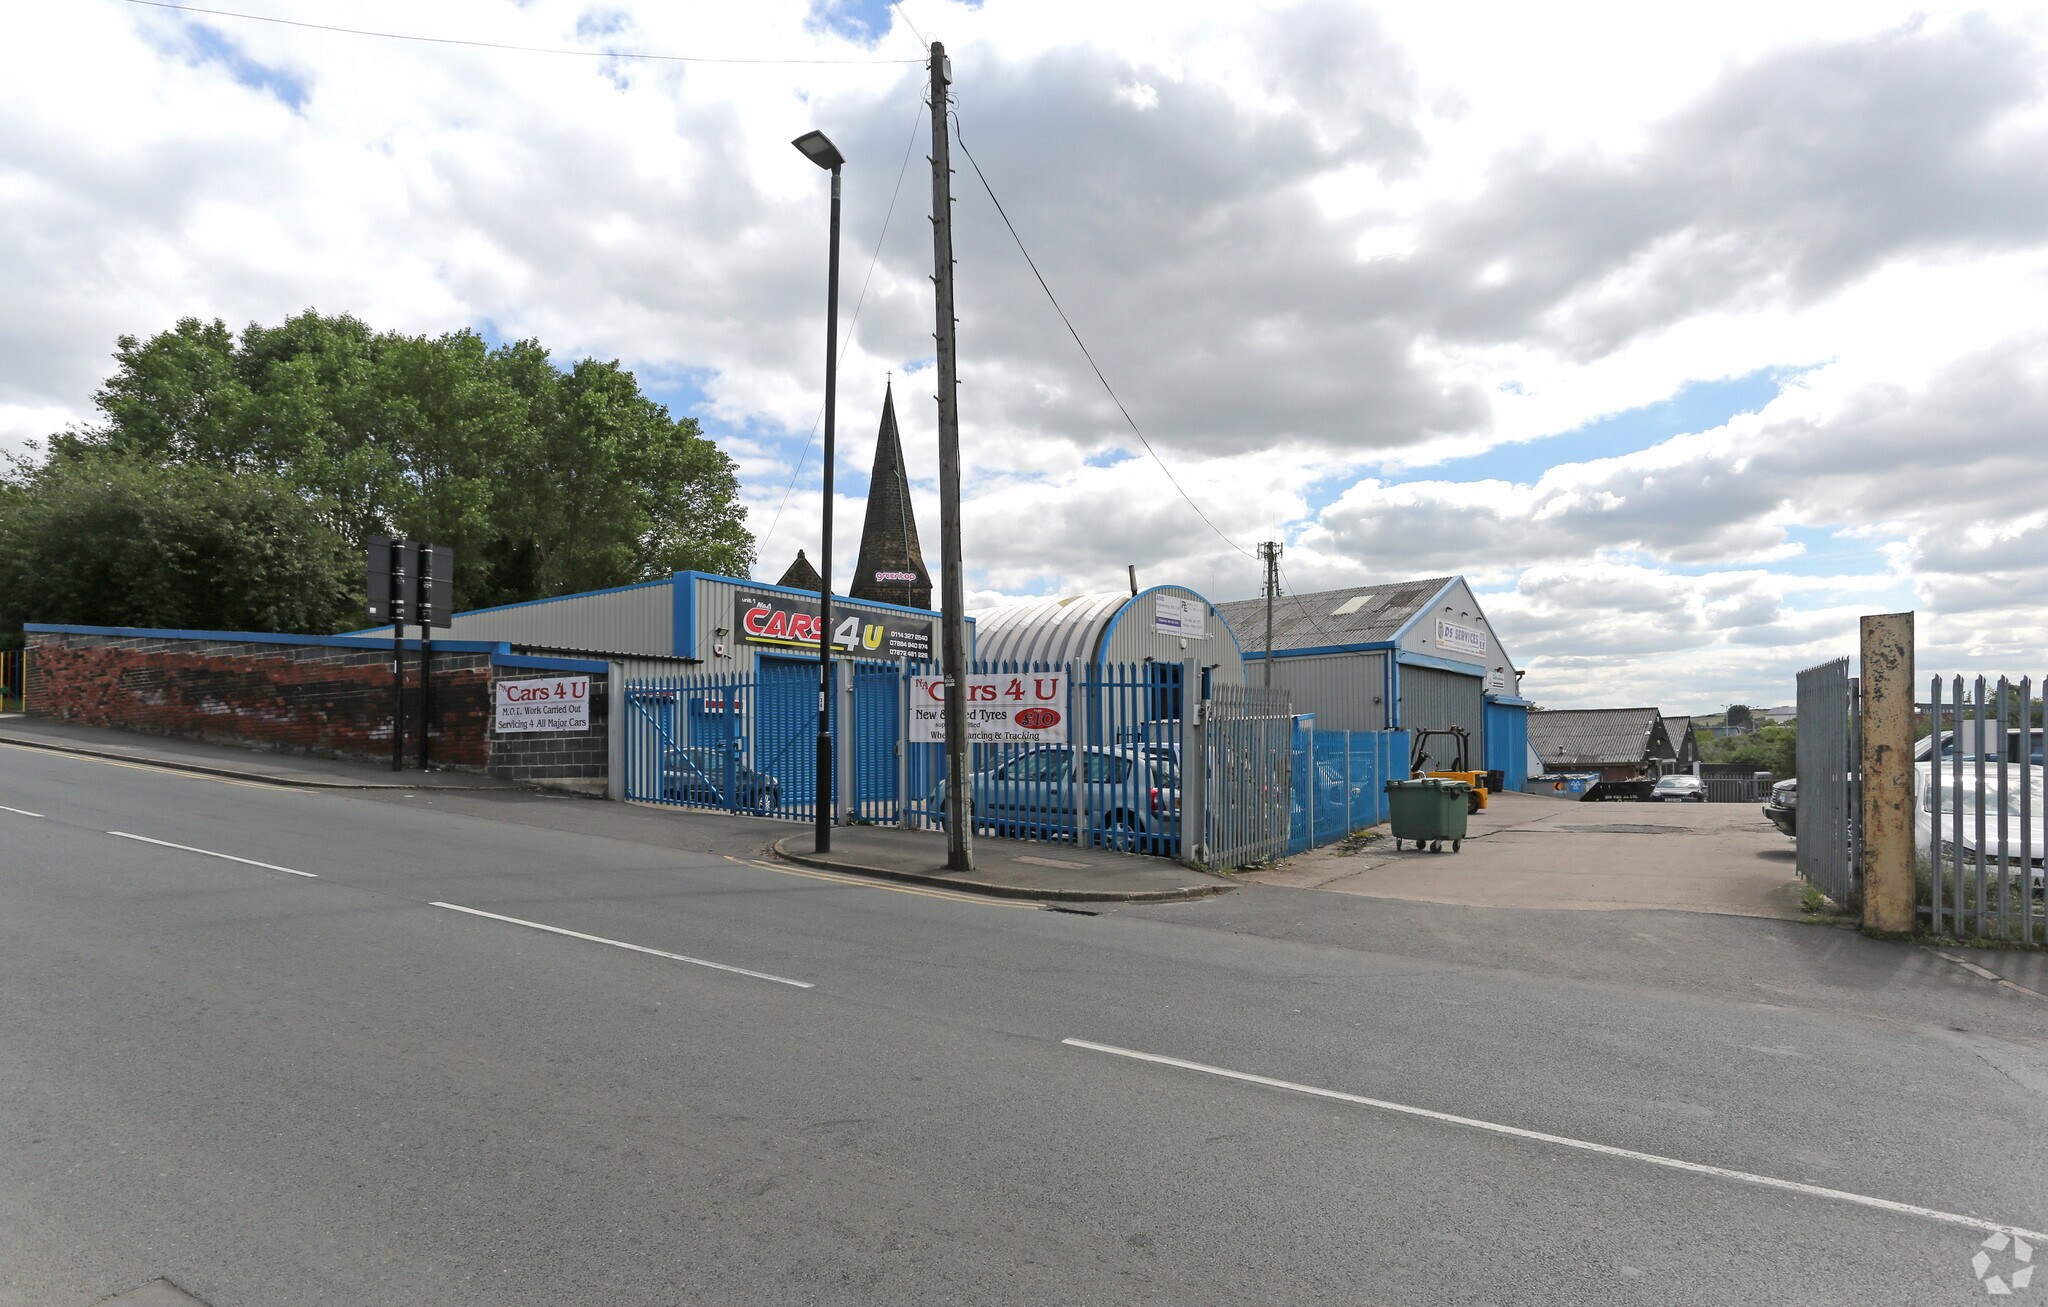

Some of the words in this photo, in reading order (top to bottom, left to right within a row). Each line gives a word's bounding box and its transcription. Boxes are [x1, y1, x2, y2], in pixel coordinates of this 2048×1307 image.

[875, 571, 916, 582] greentop
[833, 616, 860, 652] 4
[863, 624, 884, 651] U
[1445, 626, 1453, 638] DS
[1455, 629, 1479, 645] SERVICES
[507, 686, 549, 702] Cars
[554, 682, 567, 699] 4
[571, 681, 587, 699] U
[928, 681, 998, 702] Crs
[1004, 678, 1026, 701] 4
[1034, 678, 1059, 701] U
[524, 706, 542, 715] Work
[543, 704, 566, 714] Carried
[568, 704, 581, 713] Out
[916, 710, 937, 720] New
[979, 710, 1007, 722] Tyres
[498, 719, 527, 730] Servicing
[529, 719, 534, 728] 4
[536, 719, 546, 728] All
[548, 719, 567, 729] Major
[569, 718, 587, 727] Cars
[1021, 712, 1054, 726] £10
[994, 731, 1002, 739] &
[1004, 731, 1040, 741] Tracking
